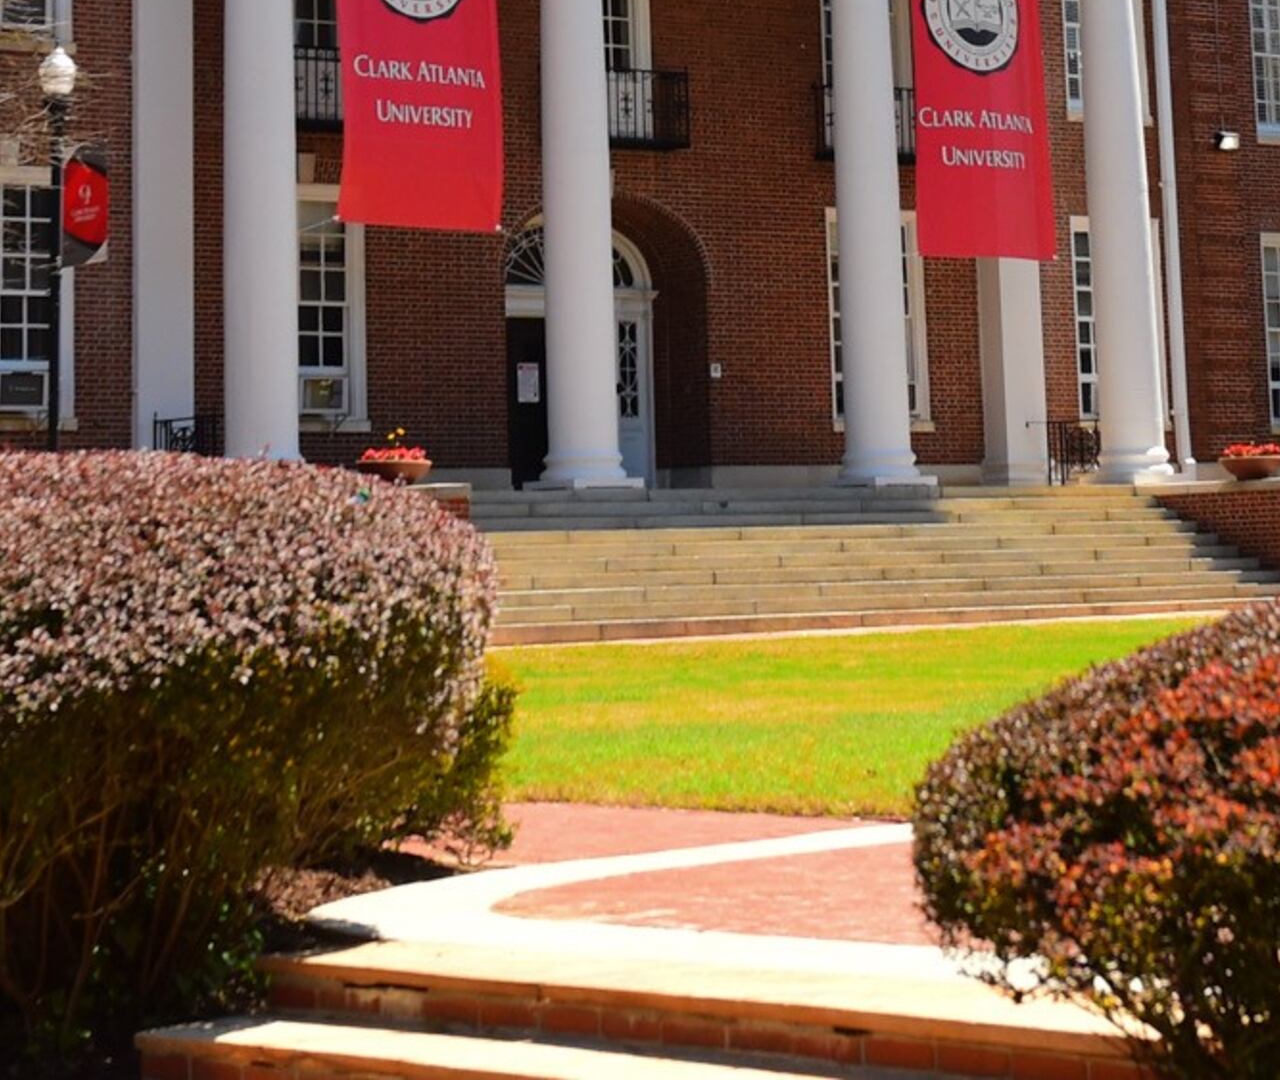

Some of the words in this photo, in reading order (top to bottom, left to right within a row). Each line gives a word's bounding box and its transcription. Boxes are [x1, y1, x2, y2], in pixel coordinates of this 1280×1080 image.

[353, 54, 414, 81] CLARK
[416, 60, 486, 89] ATLANTA
[376, 98, 473, 129] UNIVERSITY
[919, 106, 976, 129] CLARK
